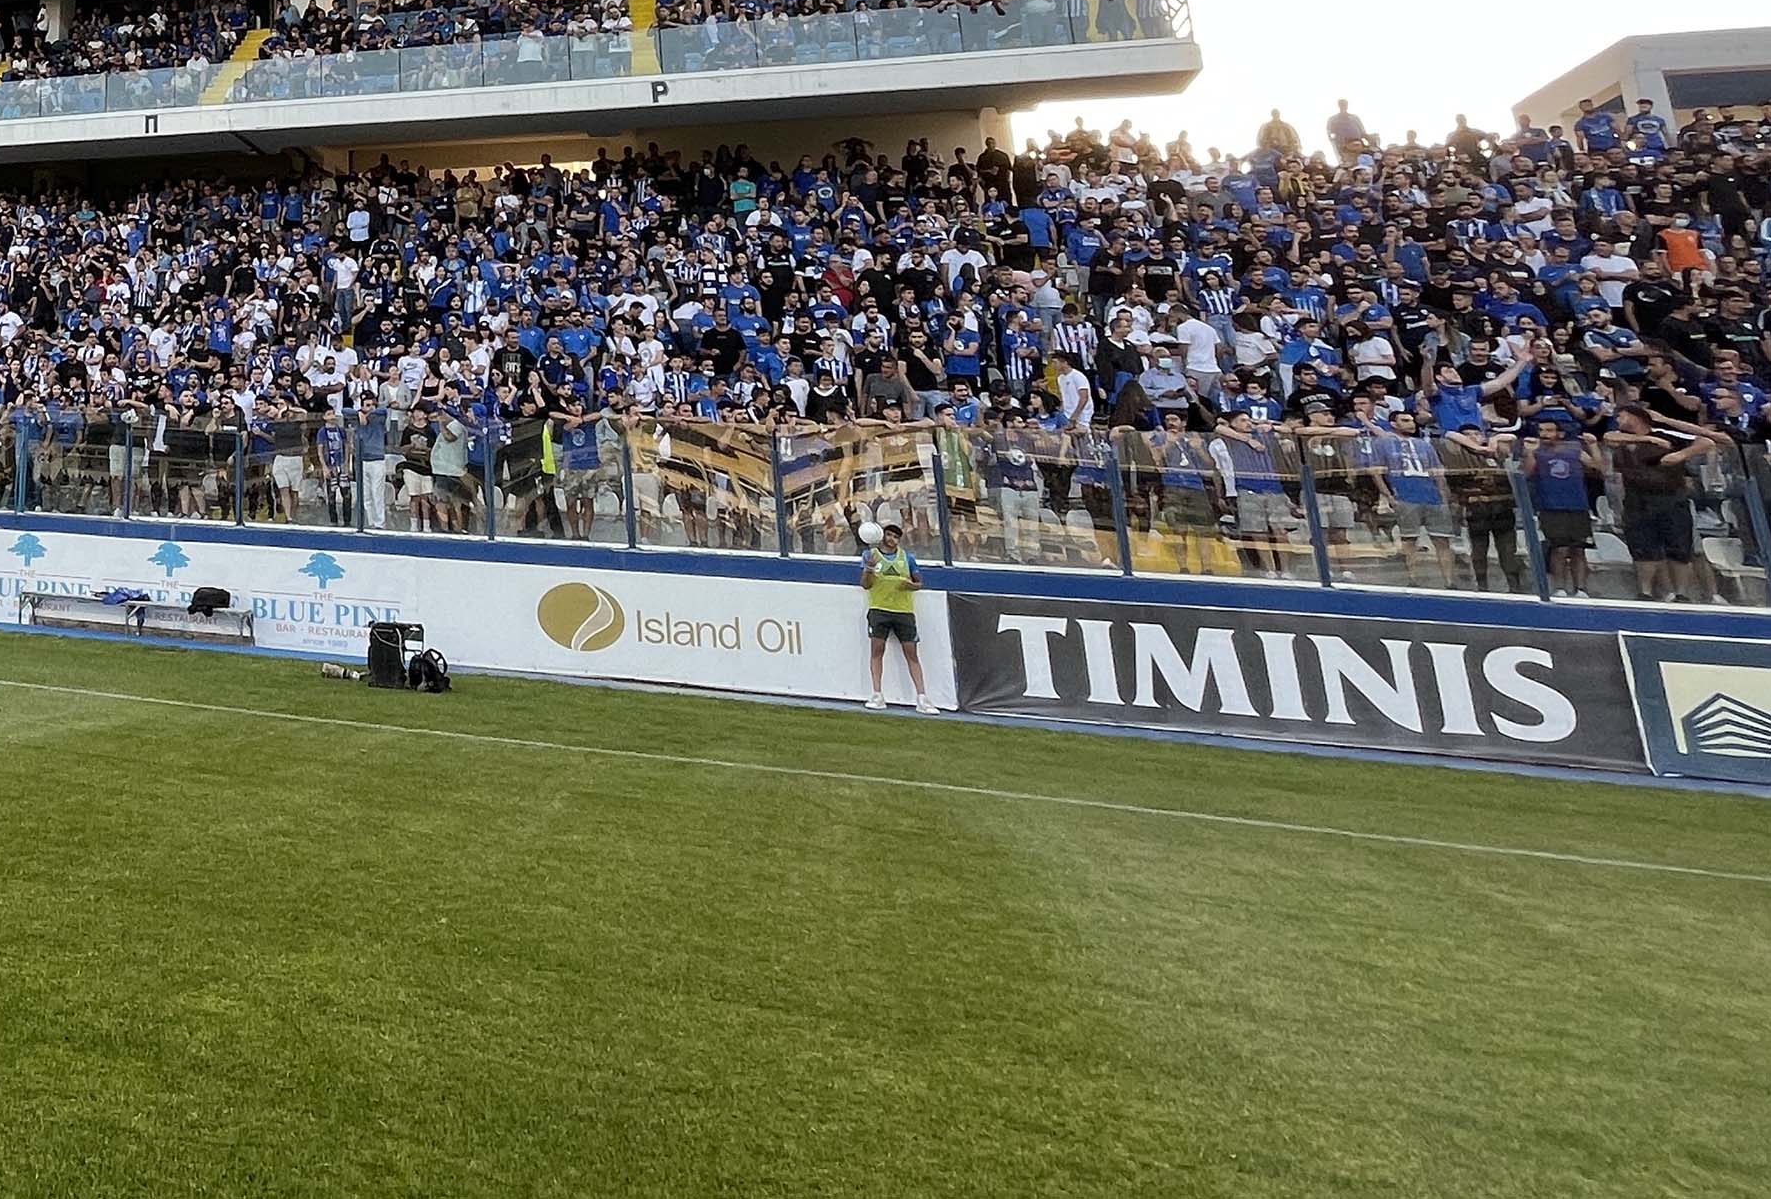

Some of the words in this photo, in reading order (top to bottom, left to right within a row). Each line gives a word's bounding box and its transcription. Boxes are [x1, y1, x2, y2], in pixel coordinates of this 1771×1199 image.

[160, 580, 179, 589] THE
[314, 592, 334, 601] THE
[252, 597, 325, 624] BLUE
[335, 603, 401, 627] PINE
[276, 623, 296, 633] BAR
[308, 626, 371, 639] RESTAURAN
[636, 609, 742, 651] Island
[756, 617, 803, 655] Oil
[996, 613, 1578, 743] TIMINIS
